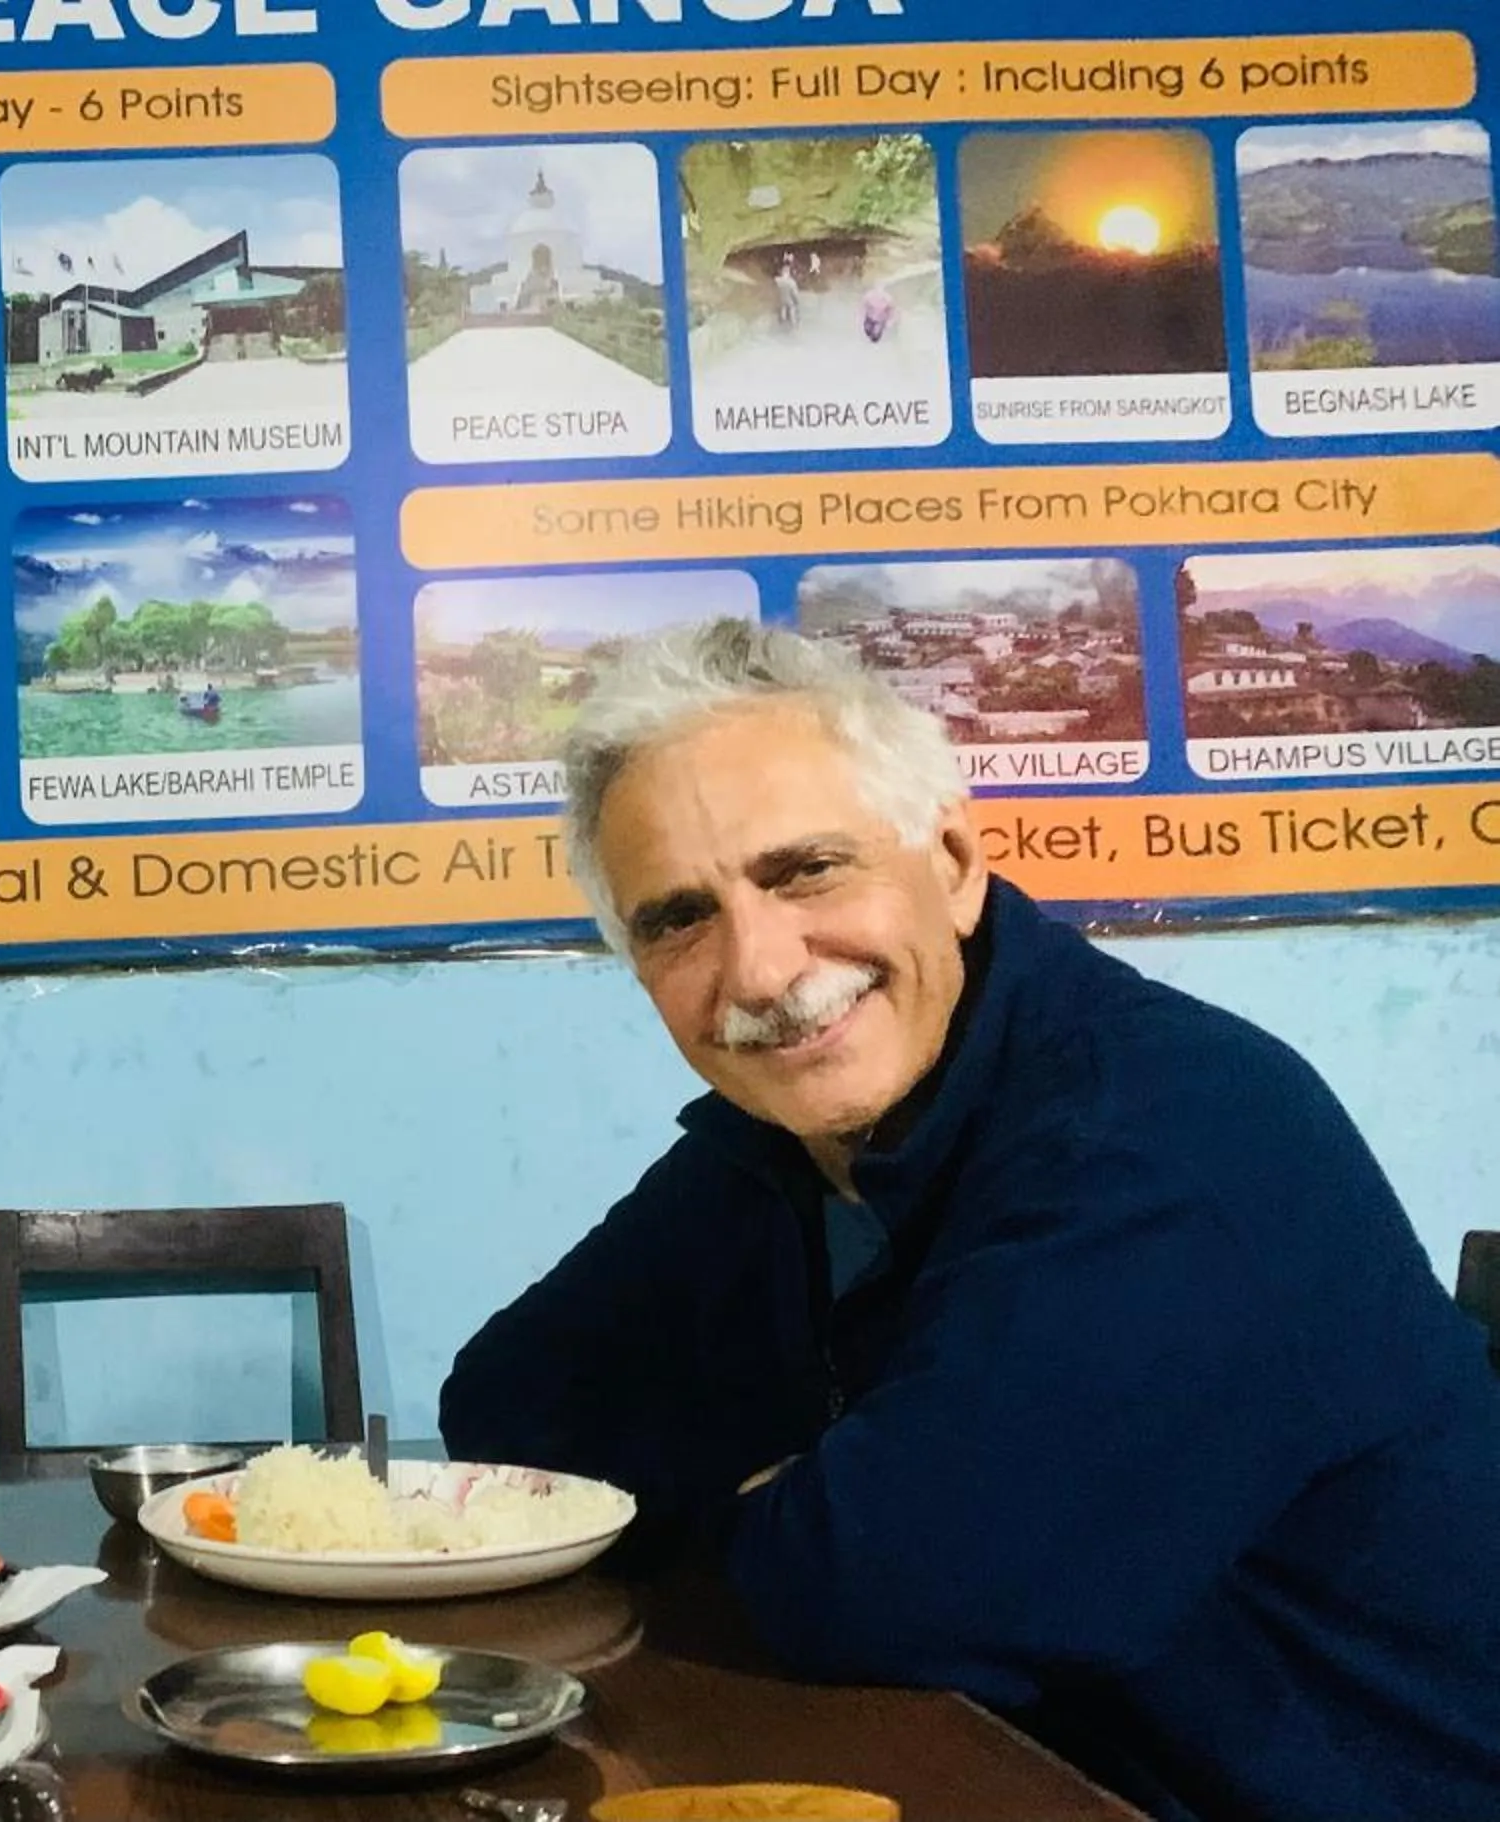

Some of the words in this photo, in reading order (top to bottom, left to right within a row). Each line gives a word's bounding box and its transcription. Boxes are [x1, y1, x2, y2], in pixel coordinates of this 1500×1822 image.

[491, 71, 753, 113] Sightseeing:
[771, 65, 840, 99] Full
[856, 64, 941, 101] Day
[983, 59, 1184, 98] Including
[1199, 57, 1225, 89] 6
[1240, 53, 1369, 95] points
[79, 89, 104, 121] 6
[120, 86, 243, 121] Points
[715, 402, 859, 431] MAHENDRA
[863, 399, 929, 427] CAVE
[976, 400, 1053, 420] SUNRISE
[1059, 399, 1111, 417] FROM
[1116, 395, 1226, 417] SARANGKOT
[1285, 387, 1407, 415] BEGNASH
[1413, 383, 1477, 410] LAKE
[17, 434, 75, 460] INT'L
[84, 429, 219, 458] MOUNTAIN
[227, 423, 342, 452] MUSEUM
[452, 413, 538, 441] PEACE
[545, 410, 628, 438] STUPA
[531, 501, 661, 535] Some
[677, 495, 803, 535] Hiking
[819, 492, 963, 526] Places
[978, 488, 1087, 521] From
[1104, 485, 1280, 517] Pokhara
[1294, 478, 1378, 517] City
[1008, 751, 1143, 780] VILLAGE
[1208, 744, 1370, 775] DHAMPUS
[1374, 735, 1500, 767] VILLAGE
[29, 774, 97, 801] FEWA
[101, 767, 254, 798] LAKE/BARAHI
[260, 762, 355, 791] TEMPLE
[67, 855, 109, 900] &
[132, 844, 420, 897] Domestic
[442, 837, 515, 884] Air
[979, 815, 1119, 863] cket,
[1144, 814, 1241, 858] Bus
[1259, 803, 1445, 854] Ticket,
